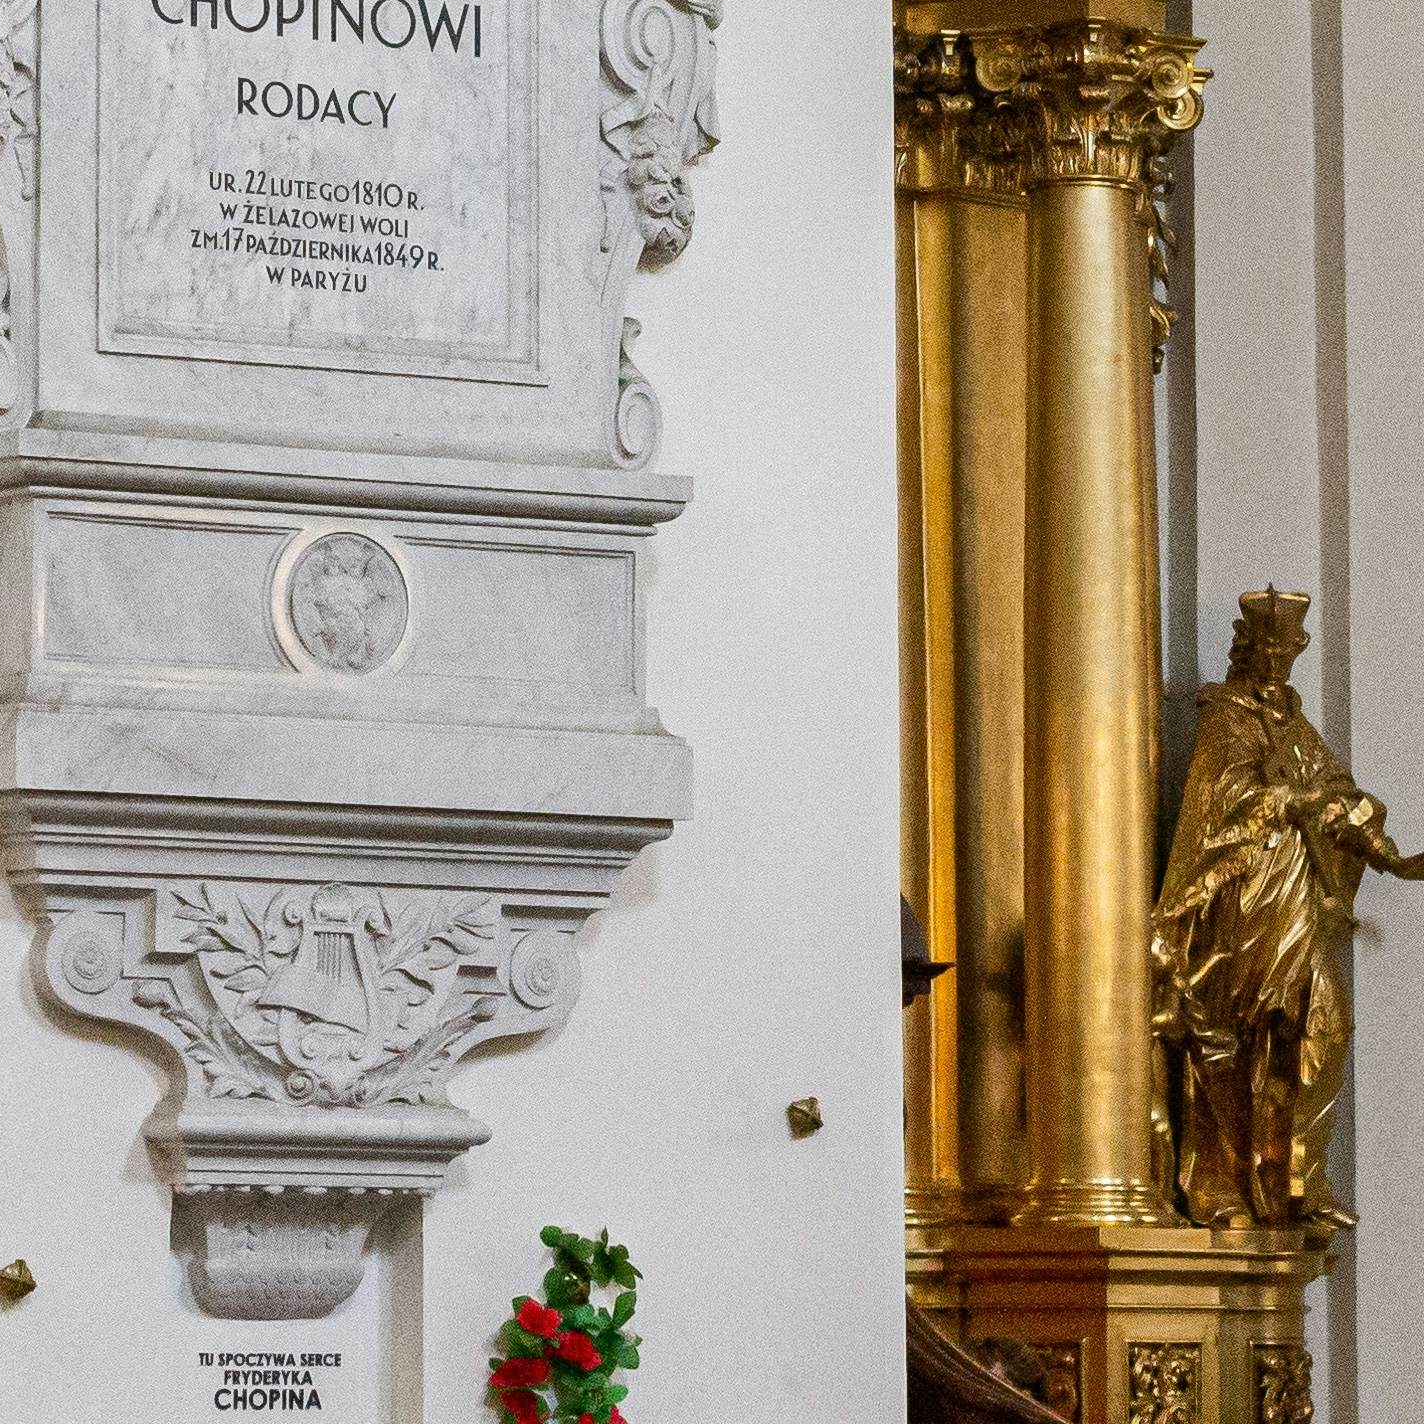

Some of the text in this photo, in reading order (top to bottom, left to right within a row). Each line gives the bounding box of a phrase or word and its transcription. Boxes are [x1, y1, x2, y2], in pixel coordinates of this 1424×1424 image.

[237, 77, 397, 128] RODACY
[209, 169, 424, 211] UR. 22 LUTEGO 1810 R.
[219, 202, 238, 220] W
[360, 215, 408, 238] WOLI
[190, 227, 445, 271] ZM. 17 PAŹDZIERNIKA 1849 R.
[266, 265, 368, 293] W PARYŻU
[199, 1352, 342, 1367] TU SPOCZYWA SERCE
[224, 1370, 313, 1385] FRYDERYKA
[214, 1388, 322, 1411] CHOPINA
